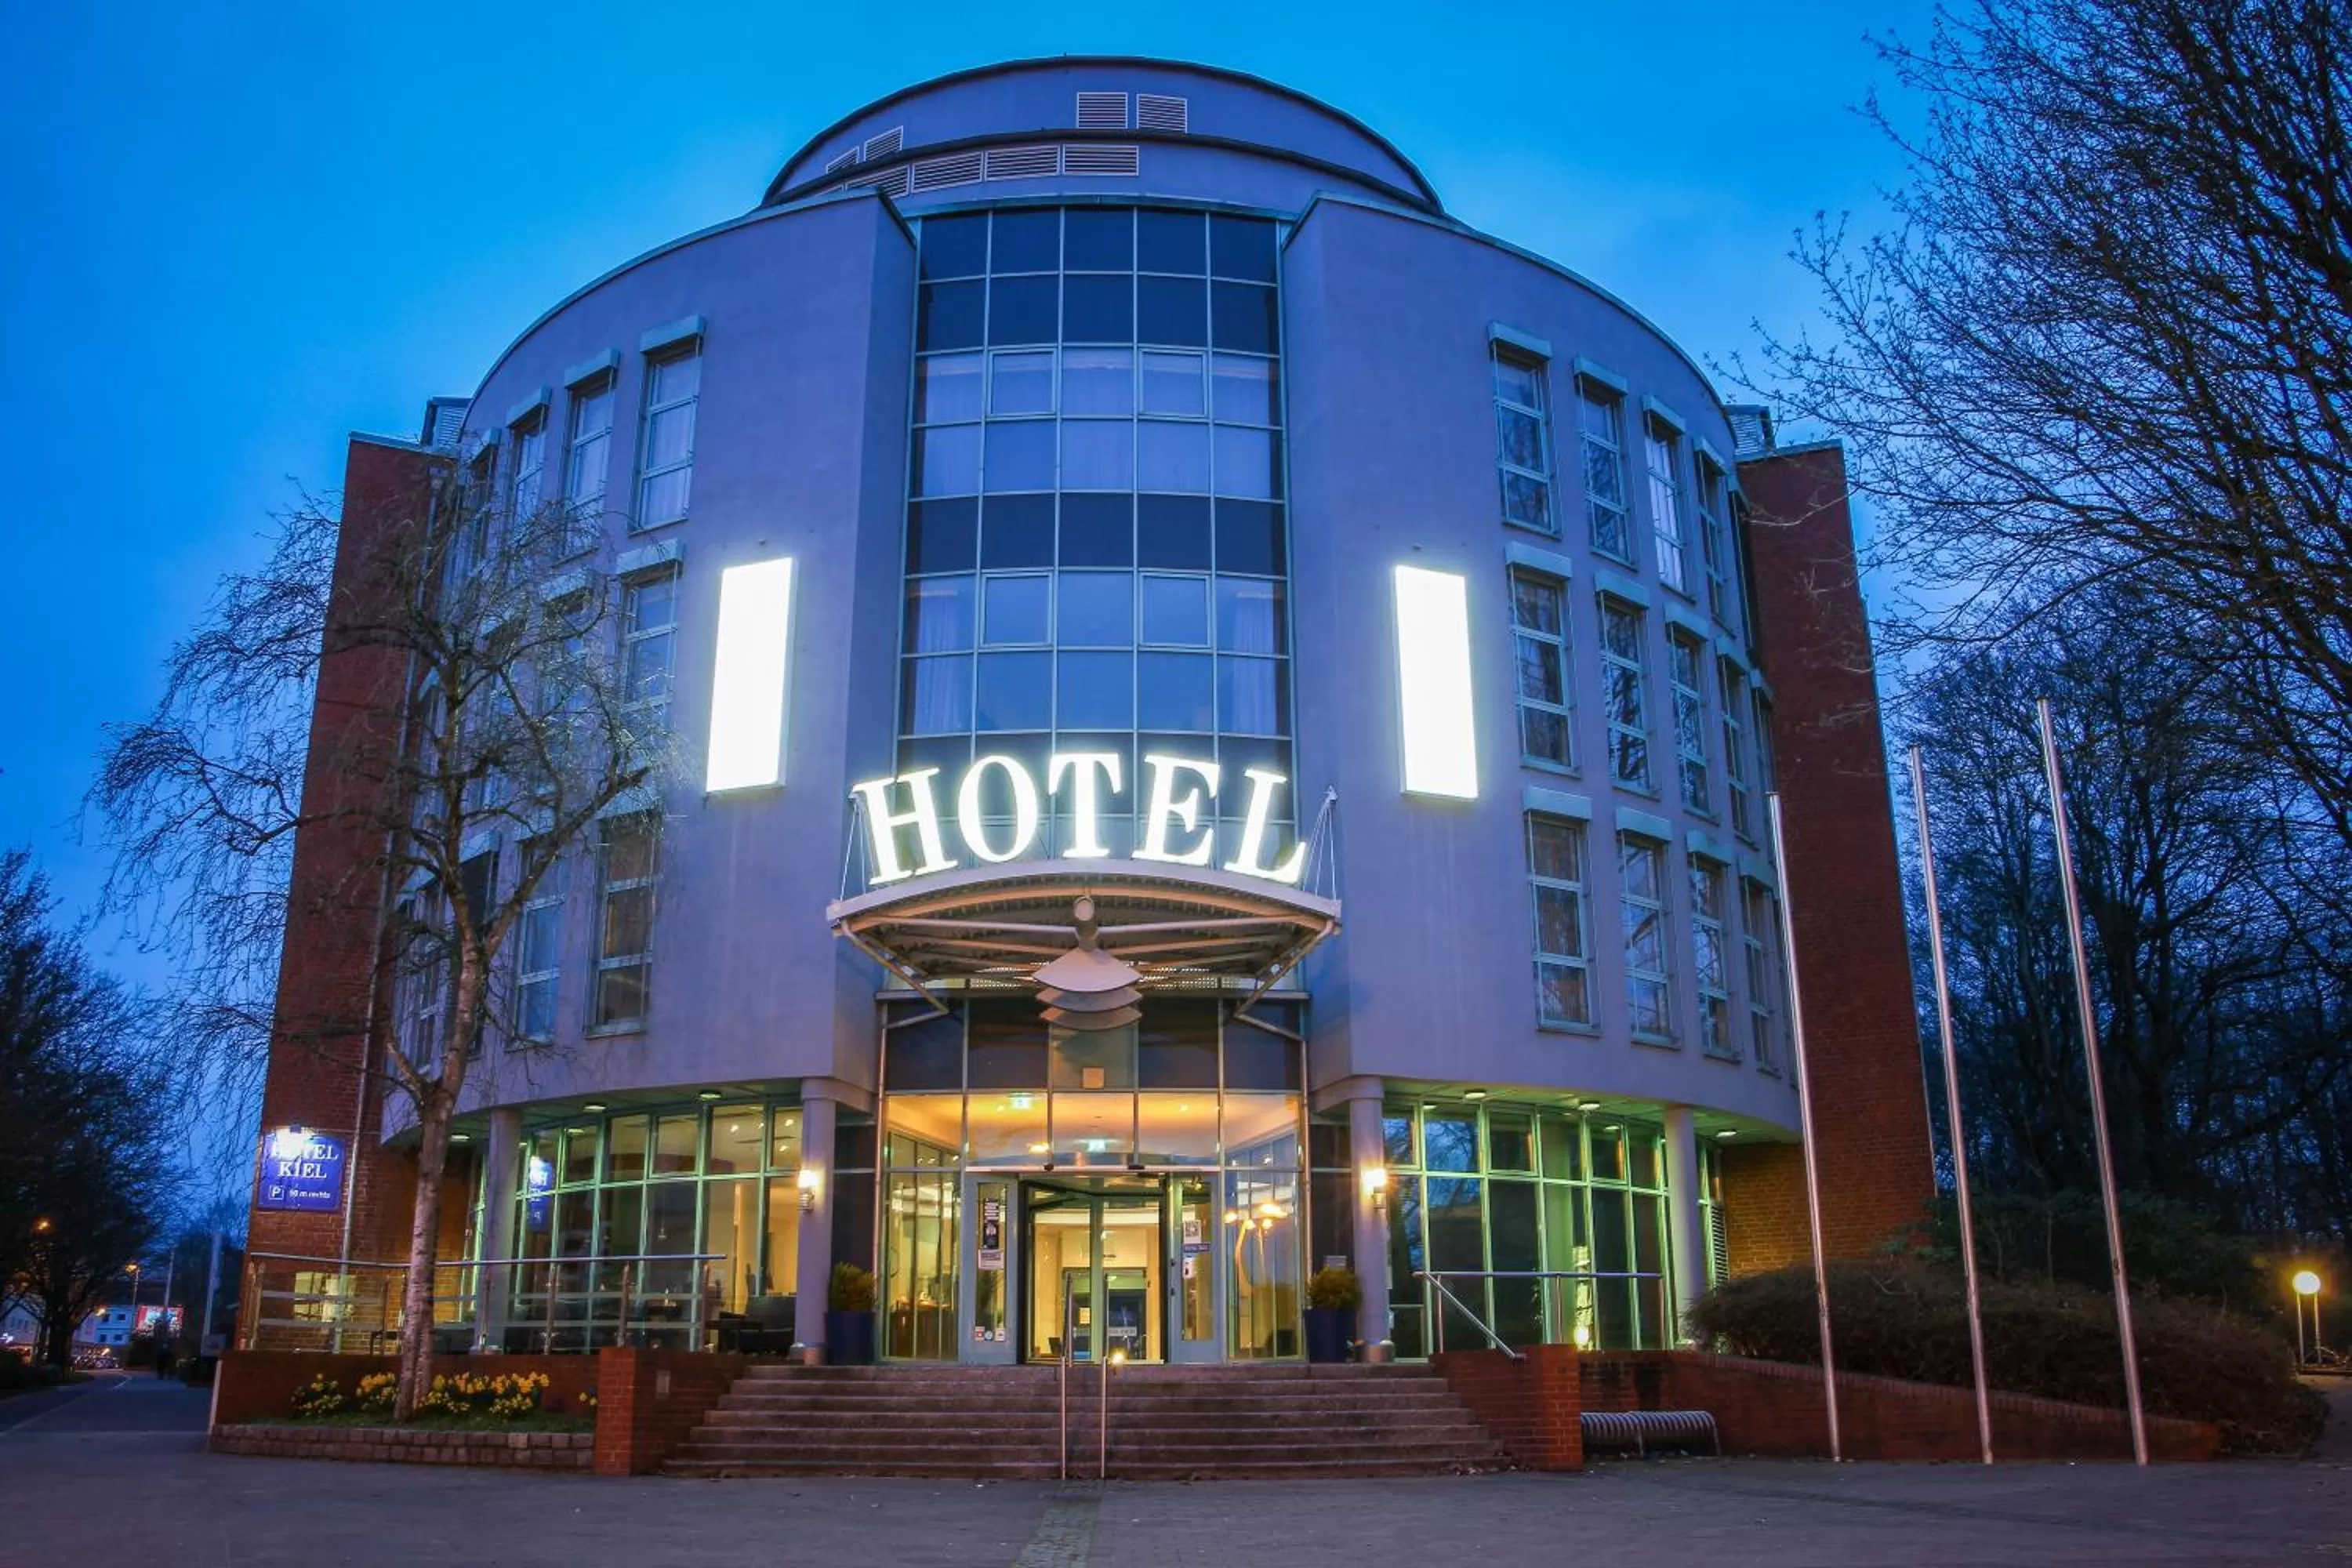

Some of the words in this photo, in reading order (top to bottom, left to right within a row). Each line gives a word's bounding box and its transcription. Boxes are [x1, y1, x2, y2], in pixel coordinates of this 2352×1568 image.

[853, 753, 1307, 885] HOTEL
[270, 1142, 339, 1160] TEL
[278, 1161, 327, 1178] KIEL
